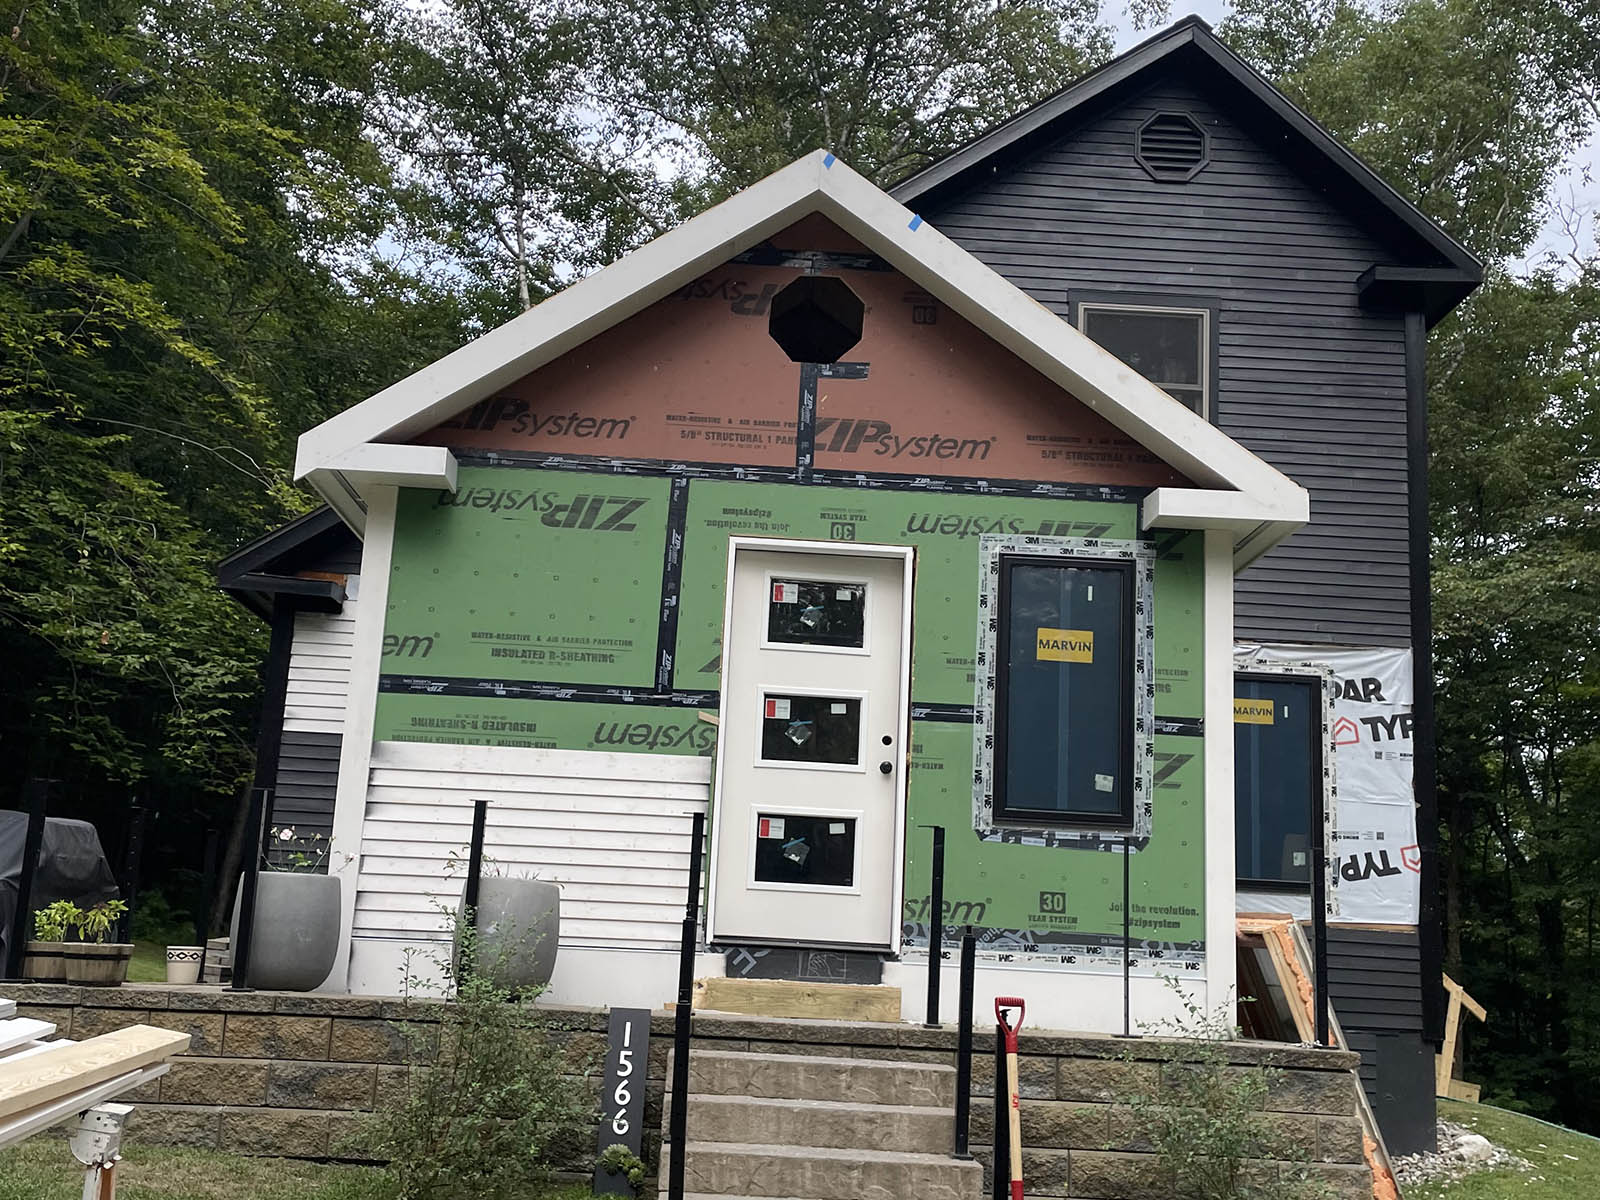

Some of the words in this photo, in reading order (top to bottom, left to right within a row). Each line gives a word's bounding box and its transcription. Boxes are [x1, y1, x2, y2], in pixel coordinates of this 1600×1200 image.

[705, 432, 763, 443] STRUCTURAL
[1025, 536, 1039, 544] 3M
[1084, 539, 1098, 547] 3M
[991, 561, 998, 575] 3M
[1146, 568, 1153, 582] 3M
[980, 595, 987, 608] 3M
[1137, 601, 1144, 615] 3M
[989, 618, 996, 632] 3M
[1147, 625, 1153, 639] 3M
[1038, 639, 1092, 652] MARVIN
[492, 648, 545, 660] INSULATED
[549, 651, 615, 663] R-SHEATHING
[978, 652, 985, 666] 3M
[1137, 659, 1144, 674] 3M
[987, 677, 994, 690] 3M
[1147, 684, 1154, 698] 3M
[976, 711, 983, 724] 3M
[1234, 707, 1272, 716] MARVIN
[1137, 718, 1144, 732] 3M
[985, 735, 992, 749] 3M
[1146, 743, 1153, 757] 3M
[975, 770, 982, 784] 3M
[1135, 777, 1142, 791] 3M
[985, 795, 992, 808] 3M
[1144, 803, 1152, 817] 3M
[1042, 893, 1064, 911] 30
[1109, 902, 1124, 911] Joi
[1131, 904, 1146, 913] the
[1149, 906, 1199, 916] revolution.
[1029, 914, 1047, 922] YEAR
[1050, 916, 1078, 924] SYSTEM
[1024, 944, 1039, 952] 3M
[1149, 950, 1163, 958] 3M
[999, 954, 1013, 962] 3M
[612, 1021, 633, 1135] 1566
